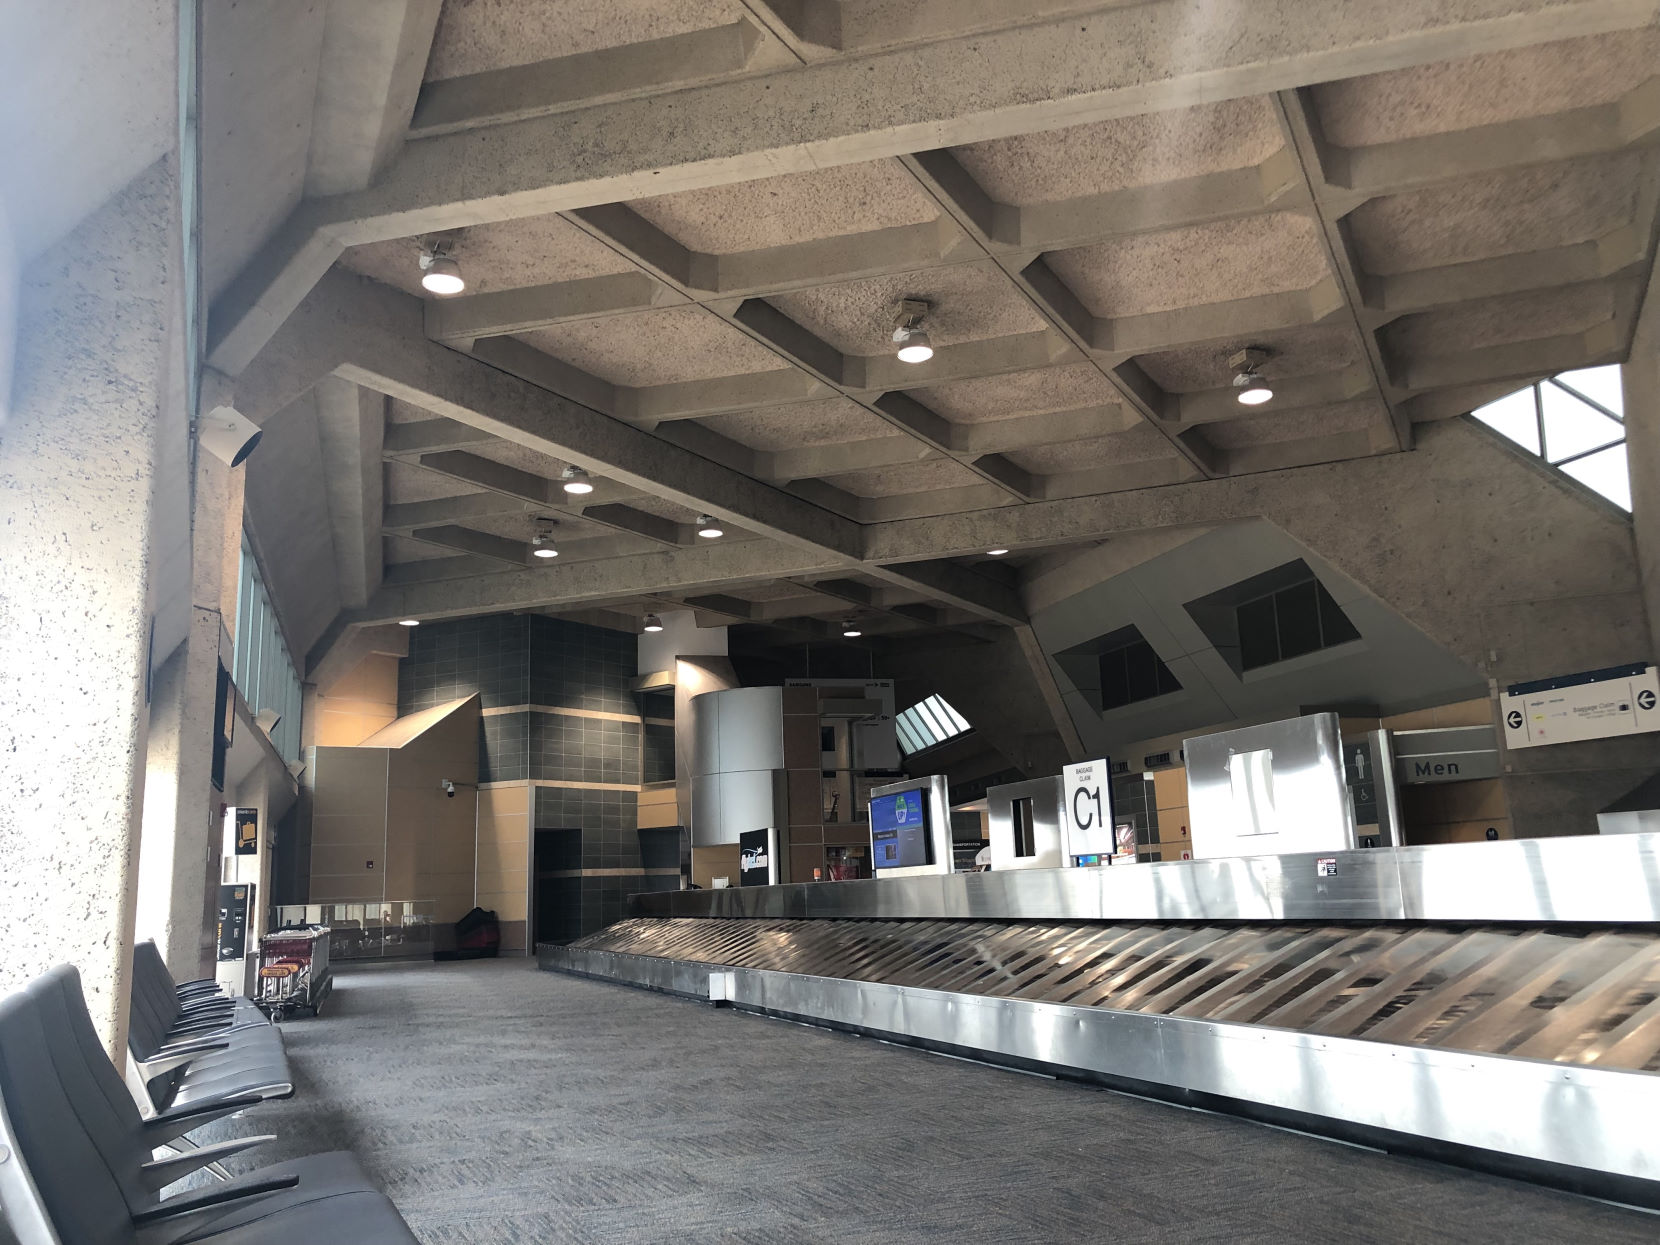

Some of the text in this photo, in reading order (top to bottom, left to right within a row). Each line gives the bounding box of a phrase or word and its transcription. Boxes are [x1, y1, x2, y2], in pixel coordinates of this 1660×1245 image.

[1573, 705, 1598, 713] Baggage
[1076, 766, 1093, 774] BAGGAGE
[1415, 761, 1459, 777] Men
[1074, 786, 1103, 831] C1
